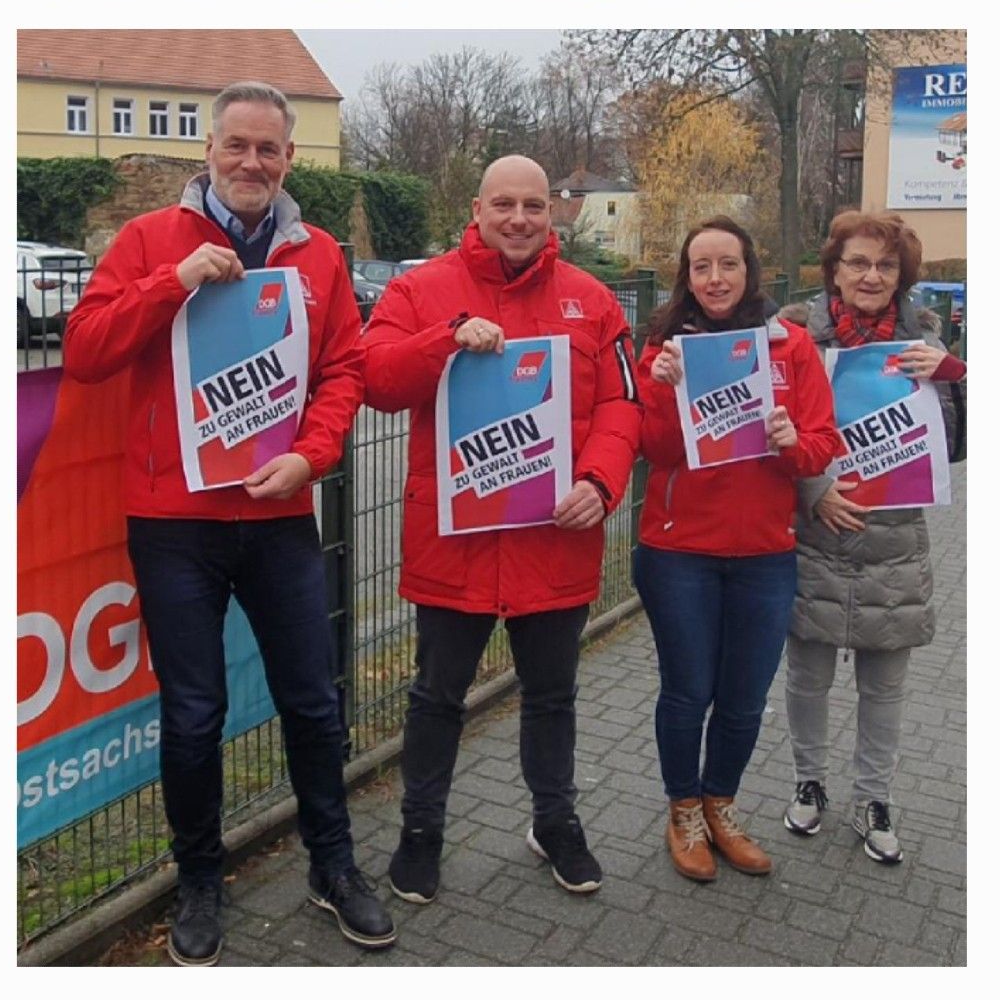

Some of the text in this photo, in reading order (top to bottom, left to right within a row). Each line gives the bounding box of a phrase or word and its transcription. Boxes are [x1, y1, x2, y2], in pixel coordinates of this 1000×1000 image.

[202, 349, 286, 414] NEIN
[696, 381, 753, 419] NEIN
[199, 395, 267, 438] ZU GEWALT
[226, 395, 297, 443] AN FRAUEN!
[842, 402, 915, 453] NEIN
[459, 413, 541, 468] NEIN
[838, 439, 898, 472] ZU GEWALT
[862, 440, 928, 477] AN FRAUEN!
[455, 452, 520, 489] ZU GEWALT
[479, 456, 552, 493] AN FRAUEN!
[17, 581, 152, 727] DG
